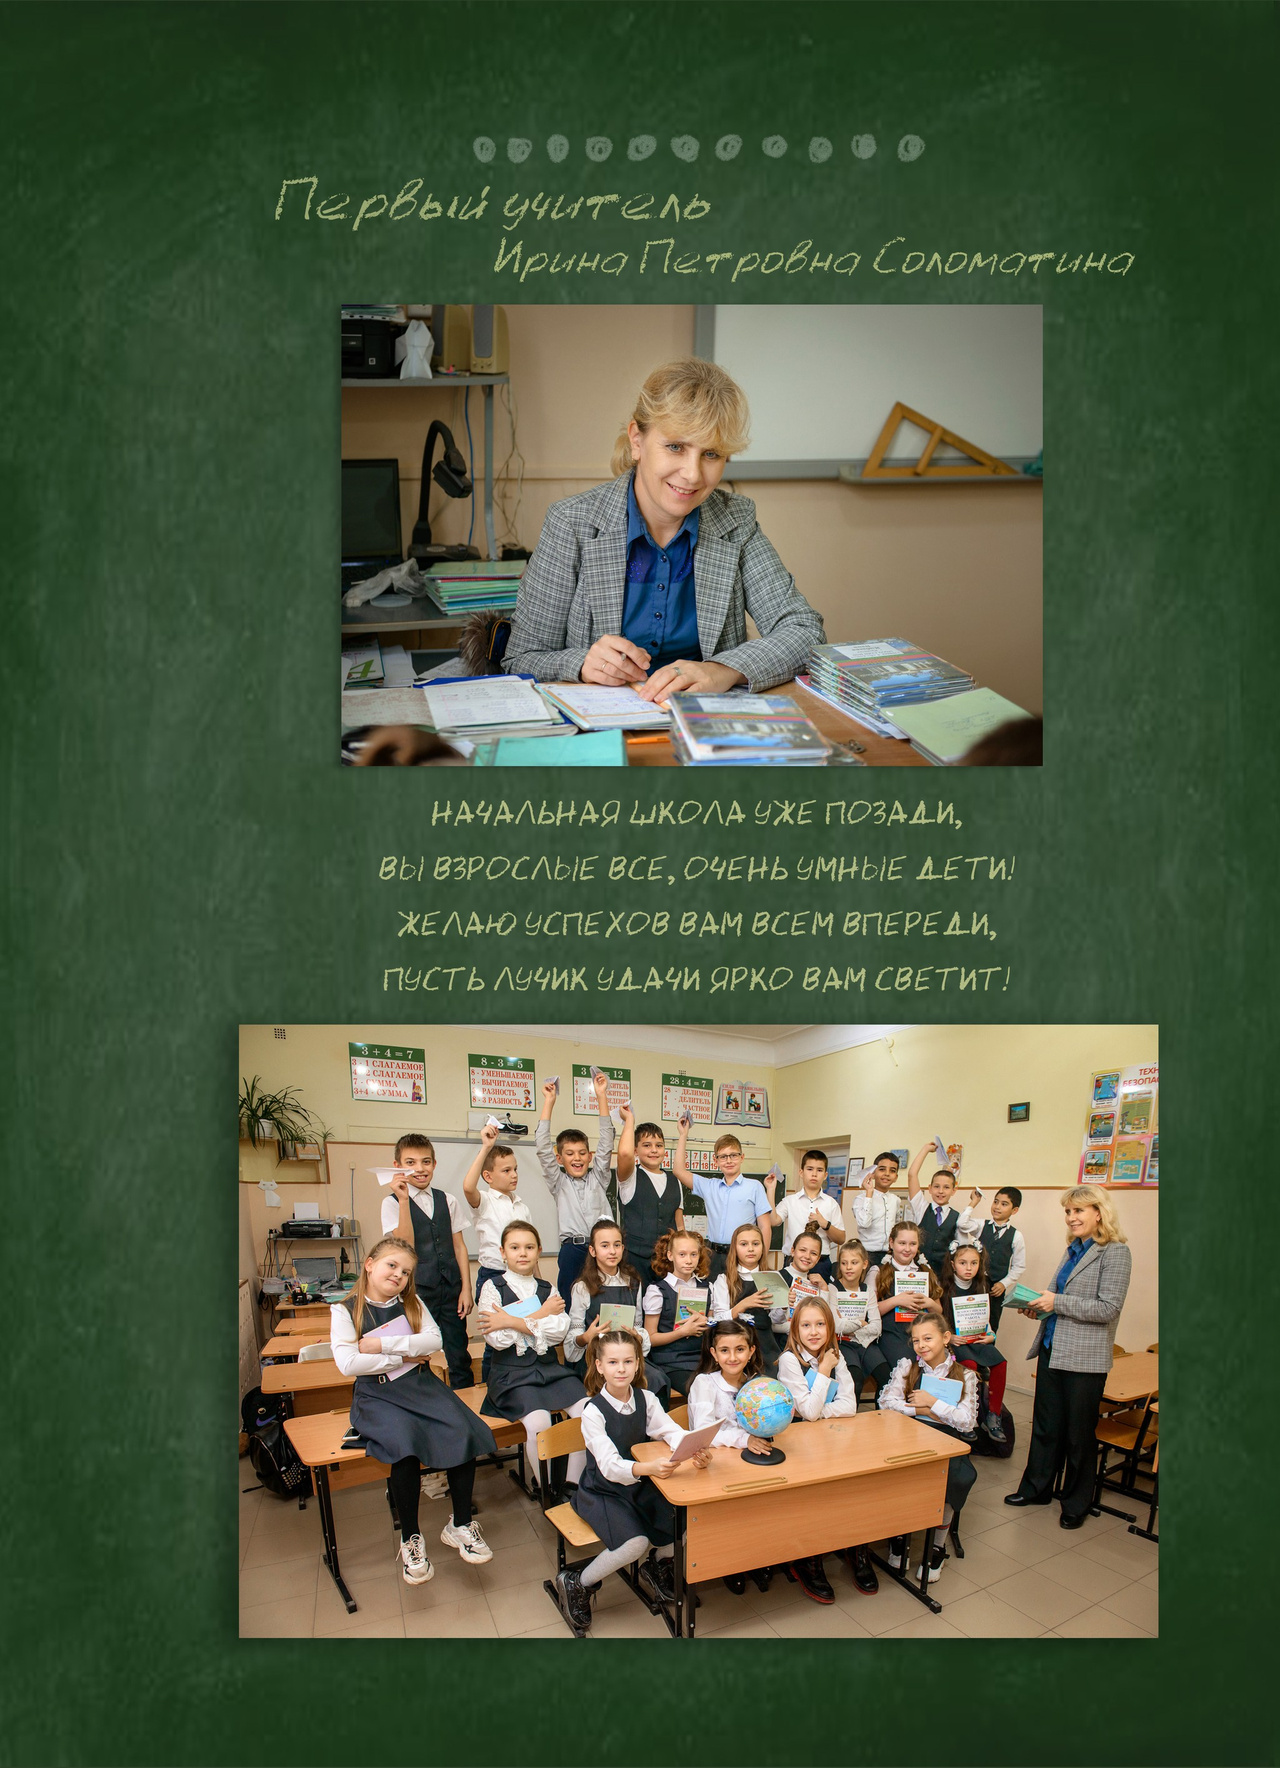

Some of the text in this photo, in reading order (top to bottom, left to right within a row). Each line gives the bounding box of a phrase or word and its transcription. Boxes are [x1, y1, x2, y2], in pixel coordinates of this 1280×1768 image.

[361, 1046, 369, 1055] 3
[384, 1049, 391, 1057] 4
[406, 1051, 413, 1059] 7
[372, 1060, 424, 1071] СЛАГАЕМОЕ
[481, 1057, 487, 1066] 8
[498, 1058, 504, 1067] 3
[517, 1061, 523, 1069] 5
[373, 1070, 424, 1080] СЛАГАЕМОЕ
[481, 1070, 533, 1080] УМЕНЬШАЕМОЕ
[581, 1067, 587, 1075] 3
[613, 1070, 623, 1078] 12
[482, 1079, 528, 1088] ВЫЧИТАЕМОЕ
[670, 1076, 680, 1085] 28
[702, 1080, 706, 1088] 7
[377, 1089, 408, 1098] СУММА
[482, 1088, 516, 1096] РАЗНОСТЬ
[682, 1089, 711, 1098] ДЕЛИМОЕ
[488, 1097, 522, 1105] РАЗНОСТЬ
[679, 1096, 711, 1105] ДЕЛИТЕЛЬ
[683, 1104, 710, 1112] ЧАСТНОЕ
